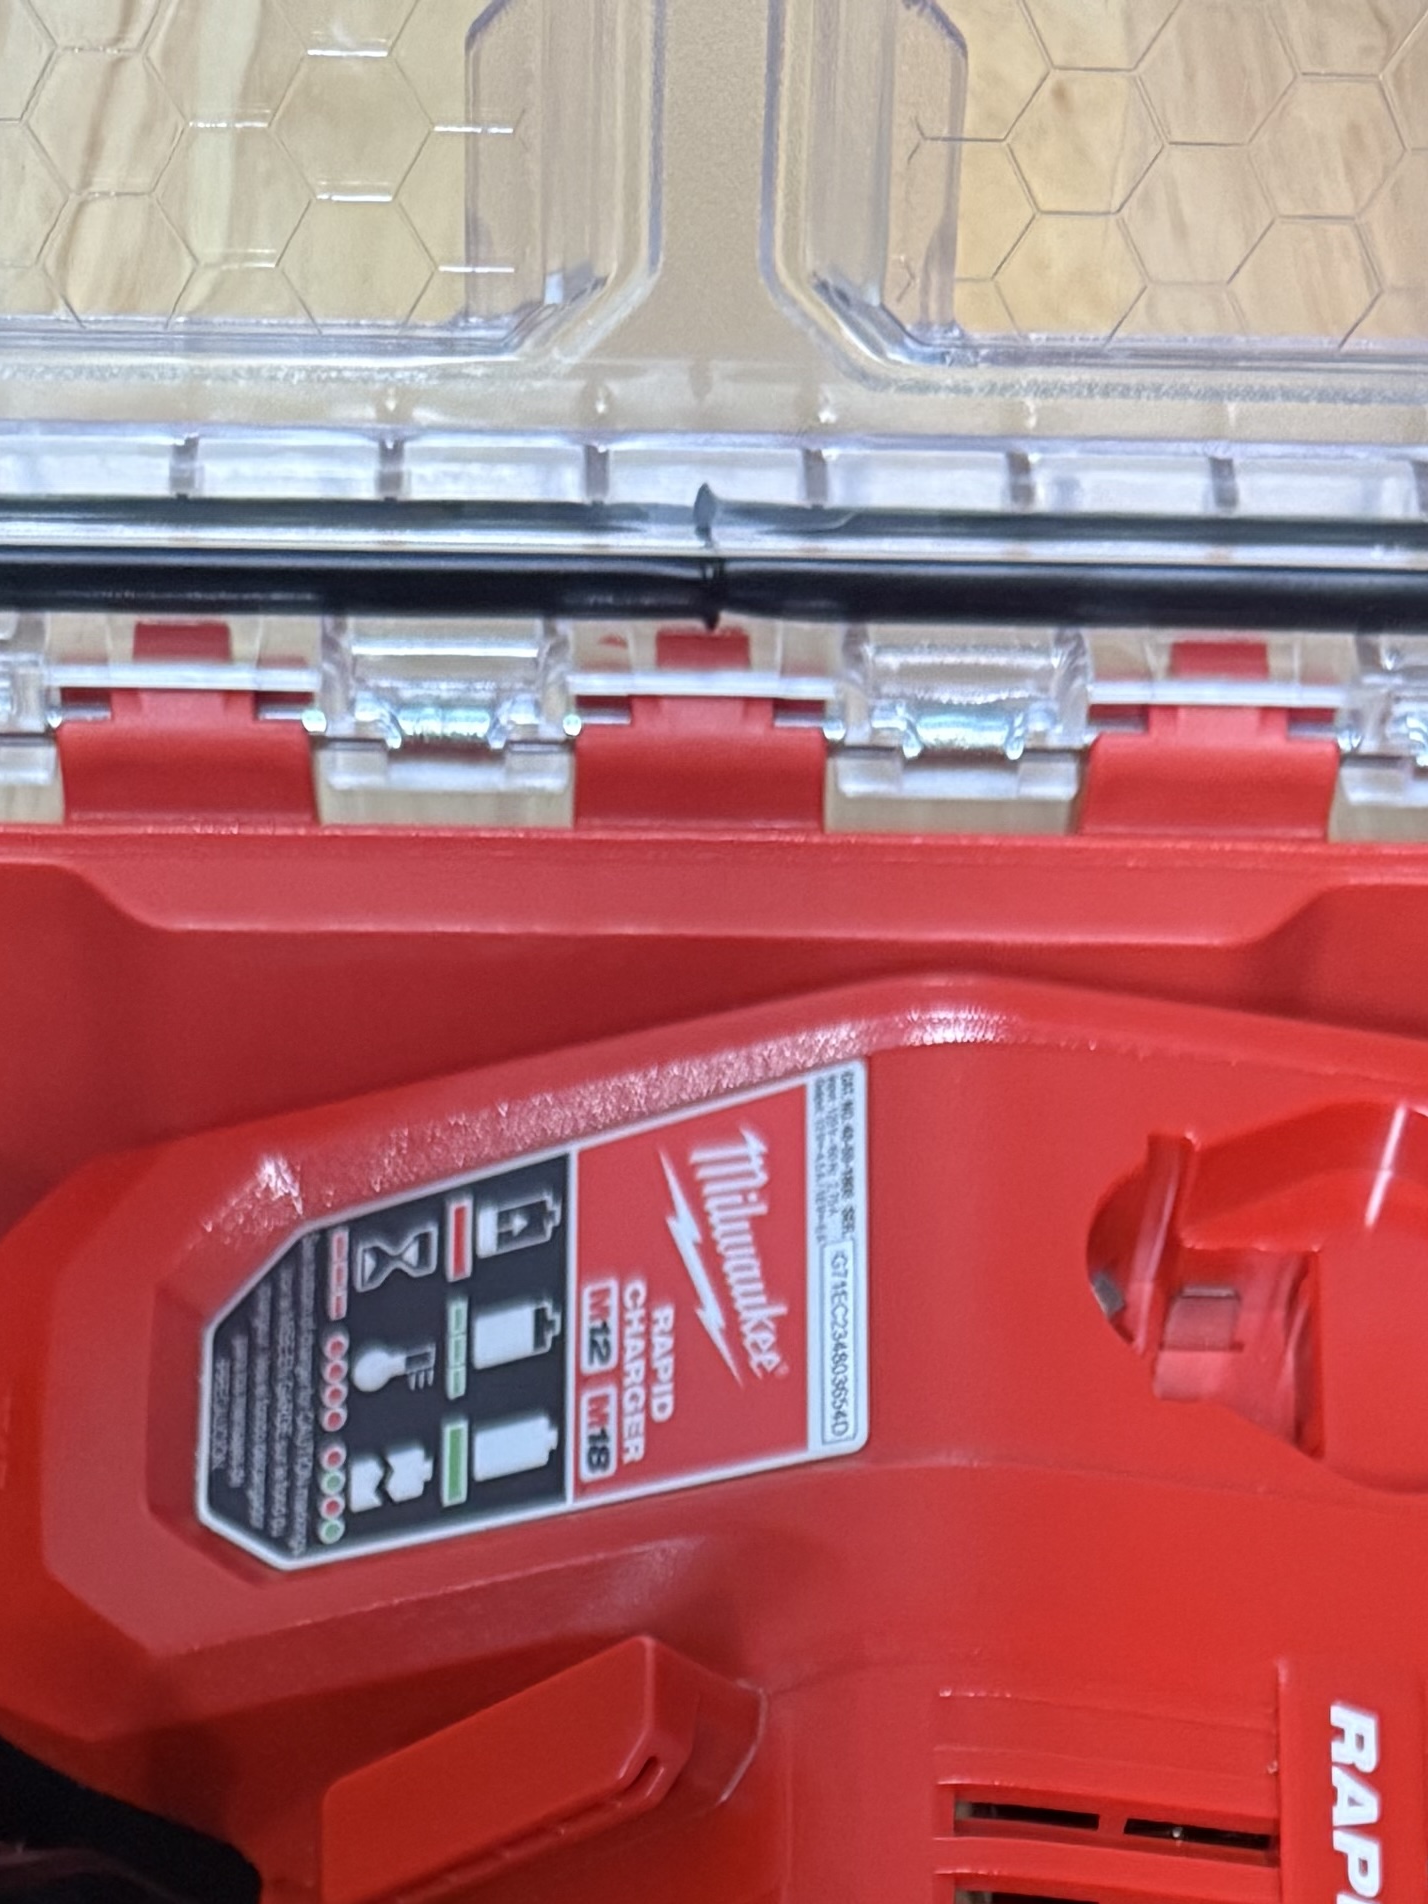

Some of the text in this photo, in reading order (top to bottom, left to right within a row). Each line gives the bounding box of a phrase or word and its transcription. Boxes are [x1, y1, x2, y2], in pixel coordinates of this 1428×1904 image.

[688, 1125, 789, 1381] Milwaukee
[585, 1285, 613, 1474] M12 M18
[622, 1279, 647, 1466] CHARGER
[650, 1303, 675, 1423] RAPID
